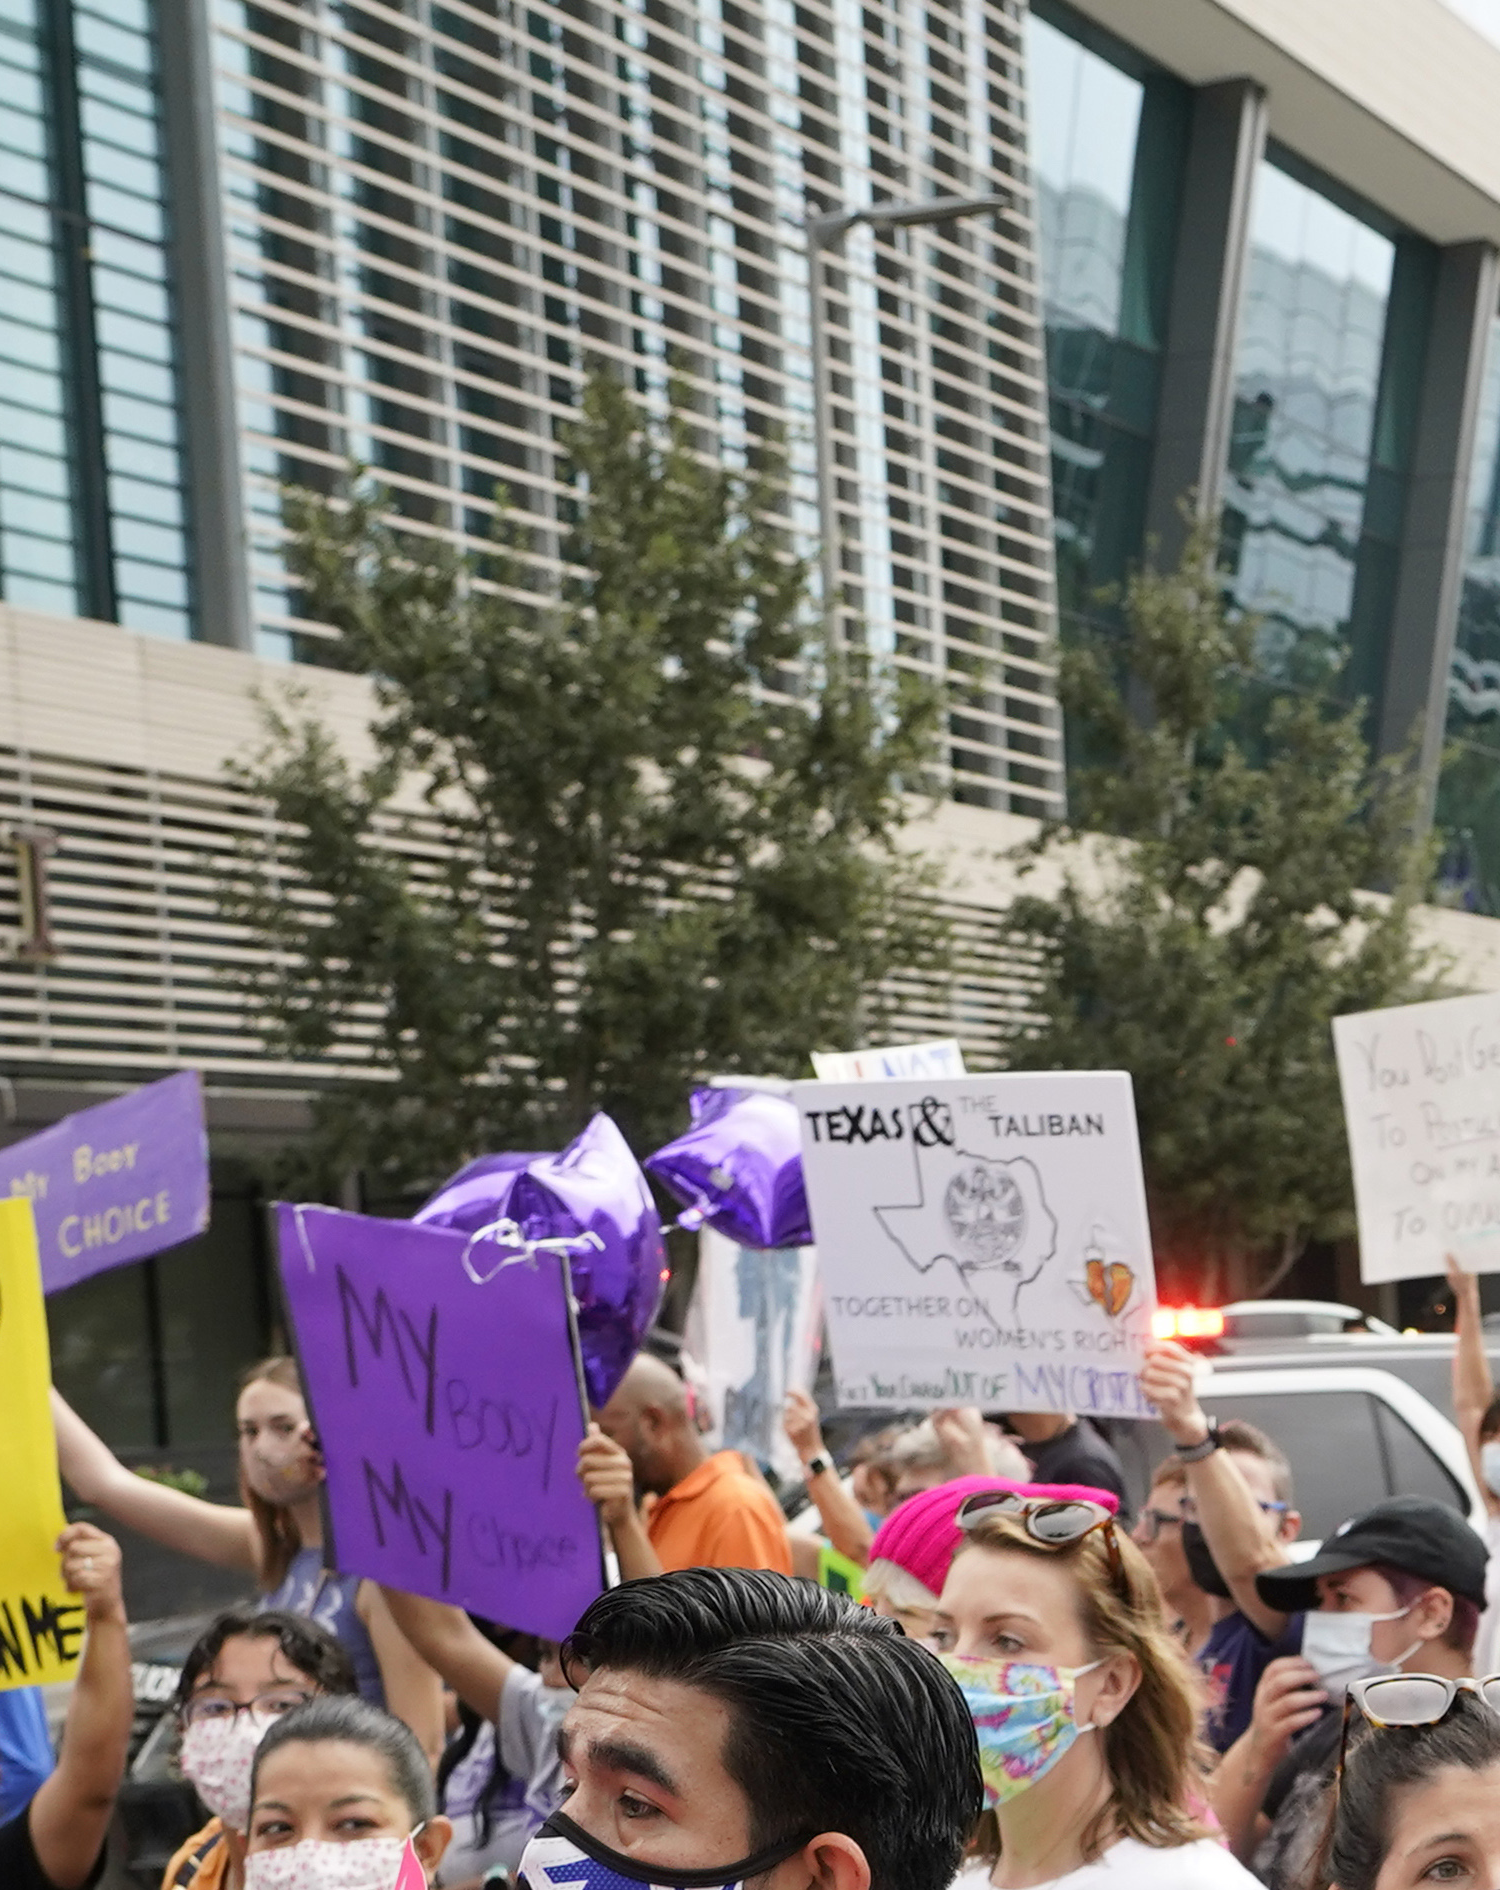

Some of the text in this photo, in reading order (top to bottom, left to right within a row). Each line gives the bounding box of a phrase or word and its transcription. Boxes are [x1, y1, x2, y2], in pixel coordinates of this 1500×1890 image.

[805, 1095, 1105, 1147] TEXAS & THE TALIBAN
[58, 1190, 171, 1258] CHOICE
[831, 1297, 951, 1317] TOGETHER
[955, 1327, 1152, 1352] WOMEN'S RIGHT
[336, 1264, 439, 1437] MY
[362, 1458, 453, 1594] MY
[19, 1595, 87, 1669] ME
